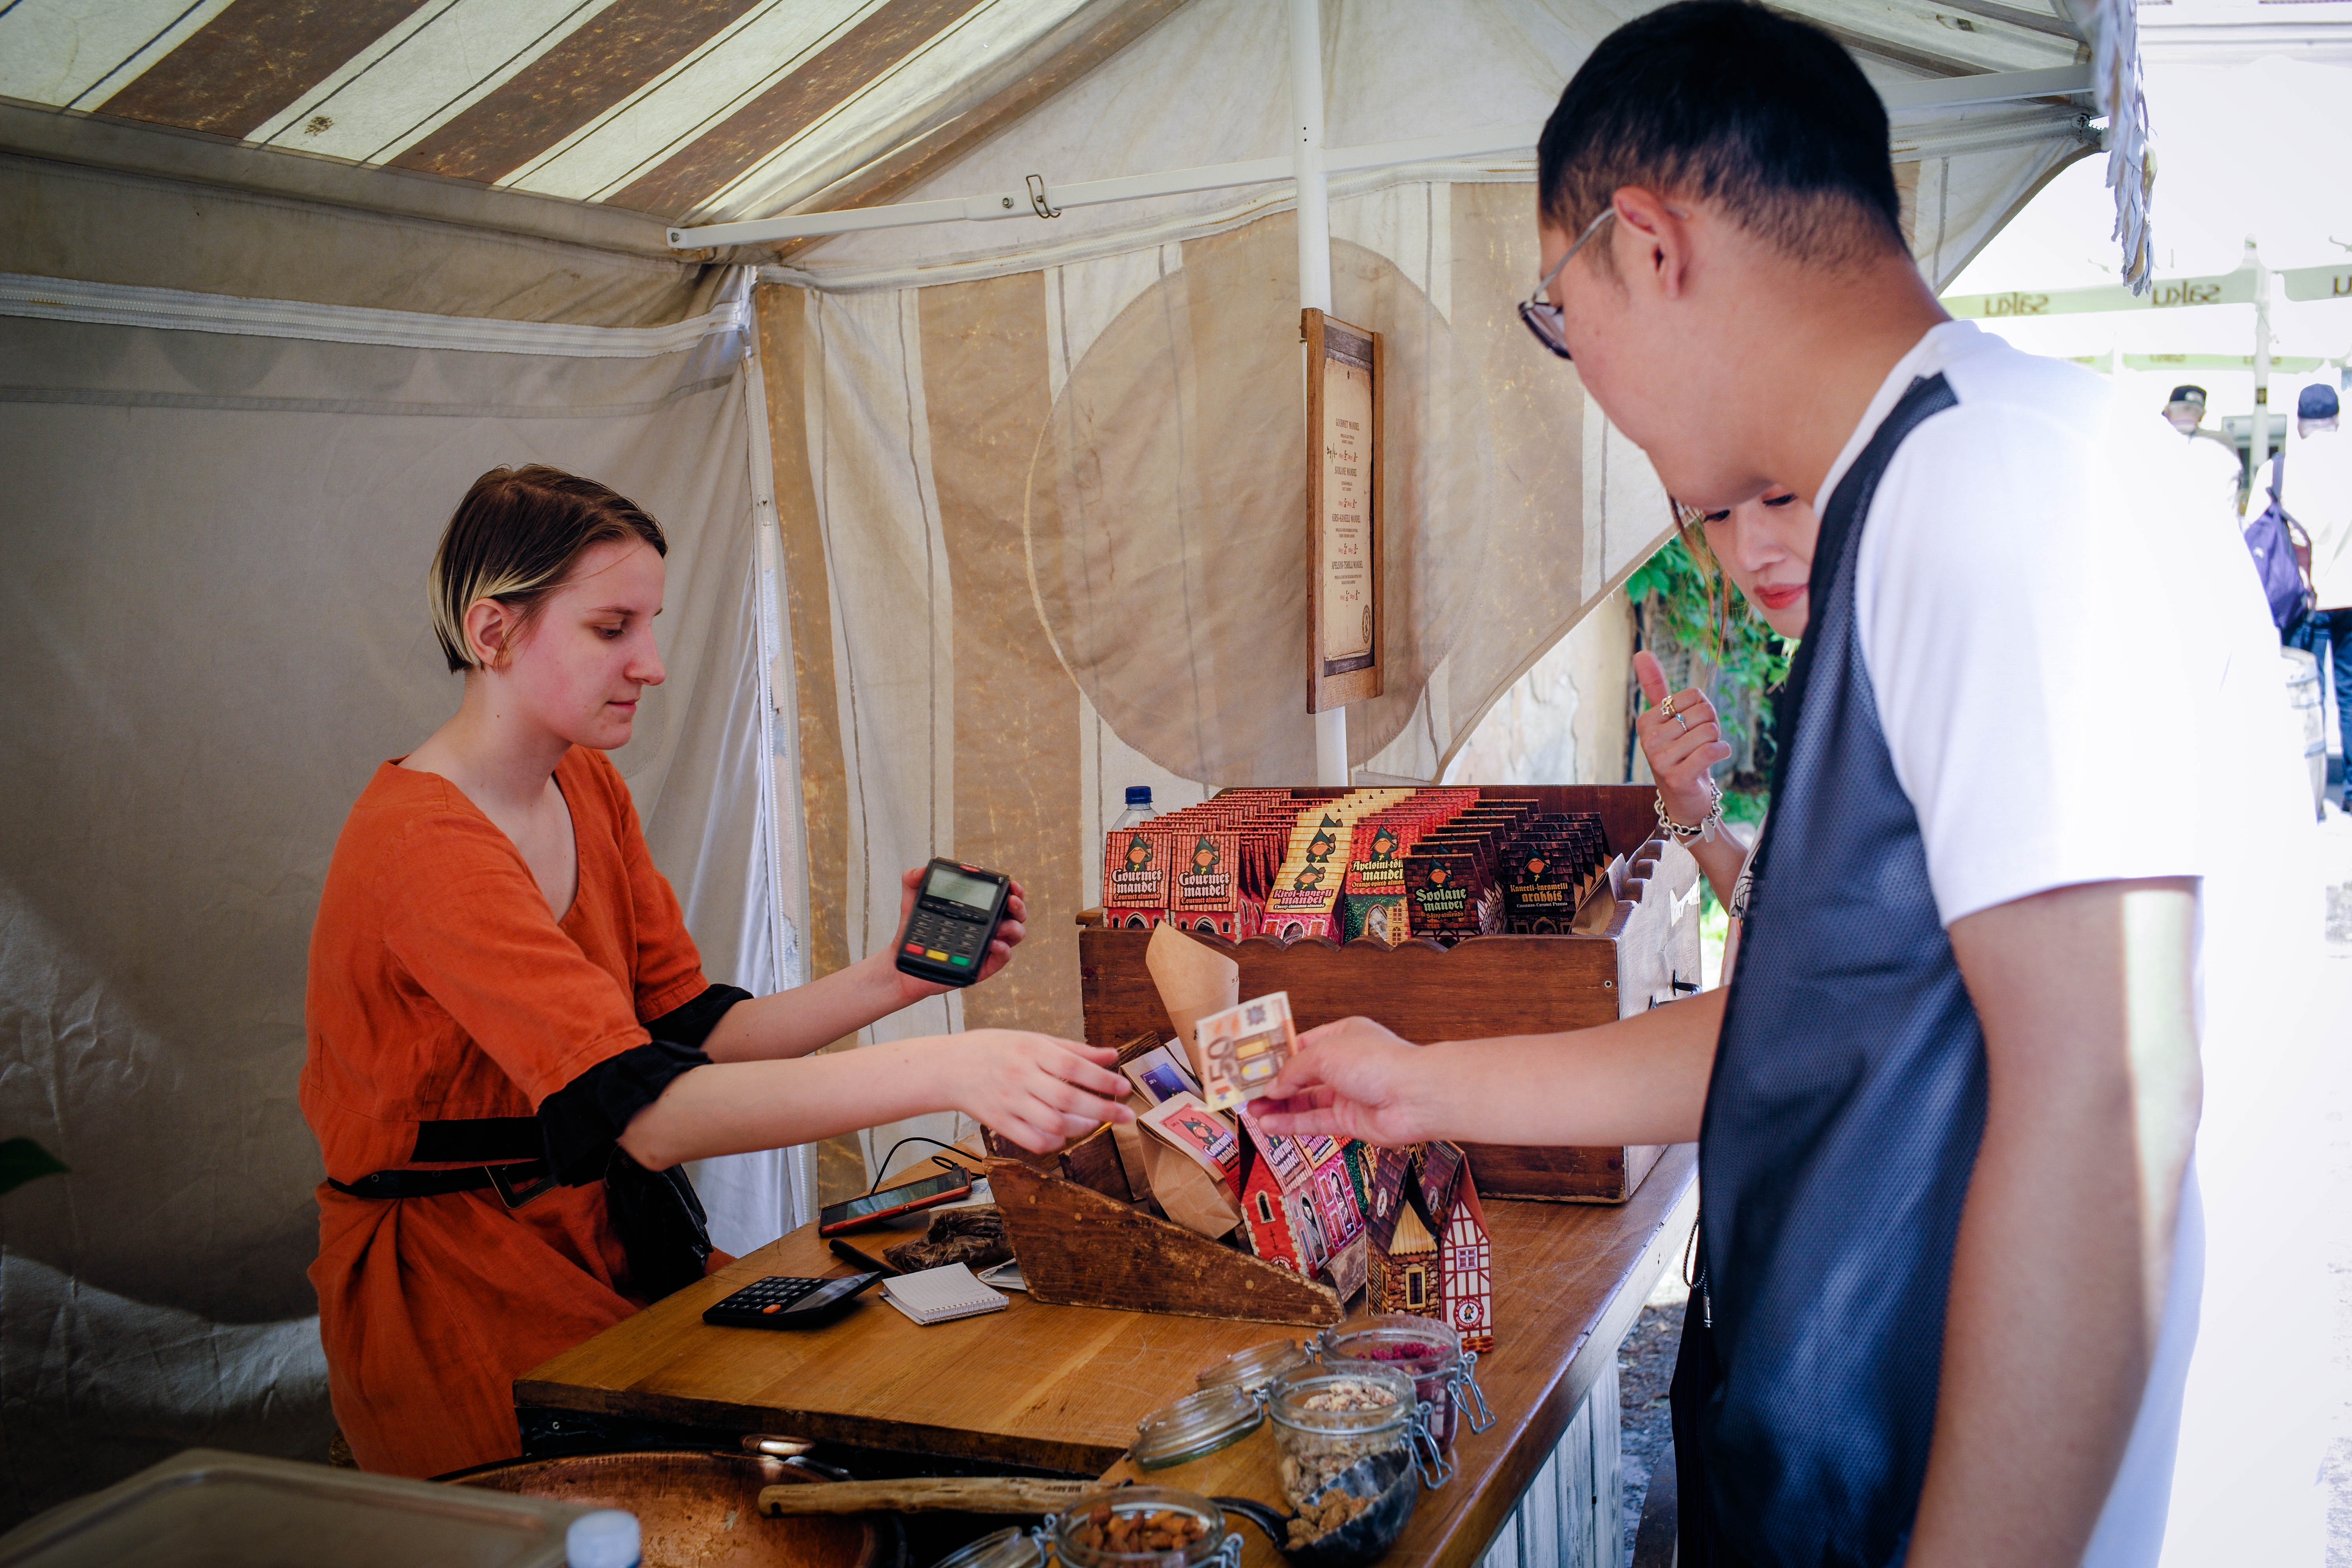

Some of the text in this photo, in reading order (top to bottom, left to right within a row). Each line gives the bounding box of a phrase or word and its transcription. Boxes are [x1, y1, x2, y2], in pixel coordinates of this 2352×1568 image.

[1112, 869, 1162, 882] Gourmet
[1179, 873, 1230, 886] Gourmet
[1362, 869, 1404, 881] mandel
[1117, 881, 1158, 893] mandel
[1184, 884, 1225, 897] mandel
[1510, 882, 1568, 892] Kaneeli-karamelli
[1281, 895, 1323, 904] mandel
[1416, 889, 1466, 902] Soolane
[1522, 890, 1562, 902] arahhis
[1423, 901, 1463, 912] mandel
[1204, 1133, 1232, 1157] Gourmet
[1268, 1136, 1294, 1165] Gourmet
[1217, 1142, 1239, 1165] mandel
[1278, 1150, 1300, 1176] mandel
[1469, 1299, 1481, 1308] MUNK
[1472, 1314, 1482, 1325] MONK
